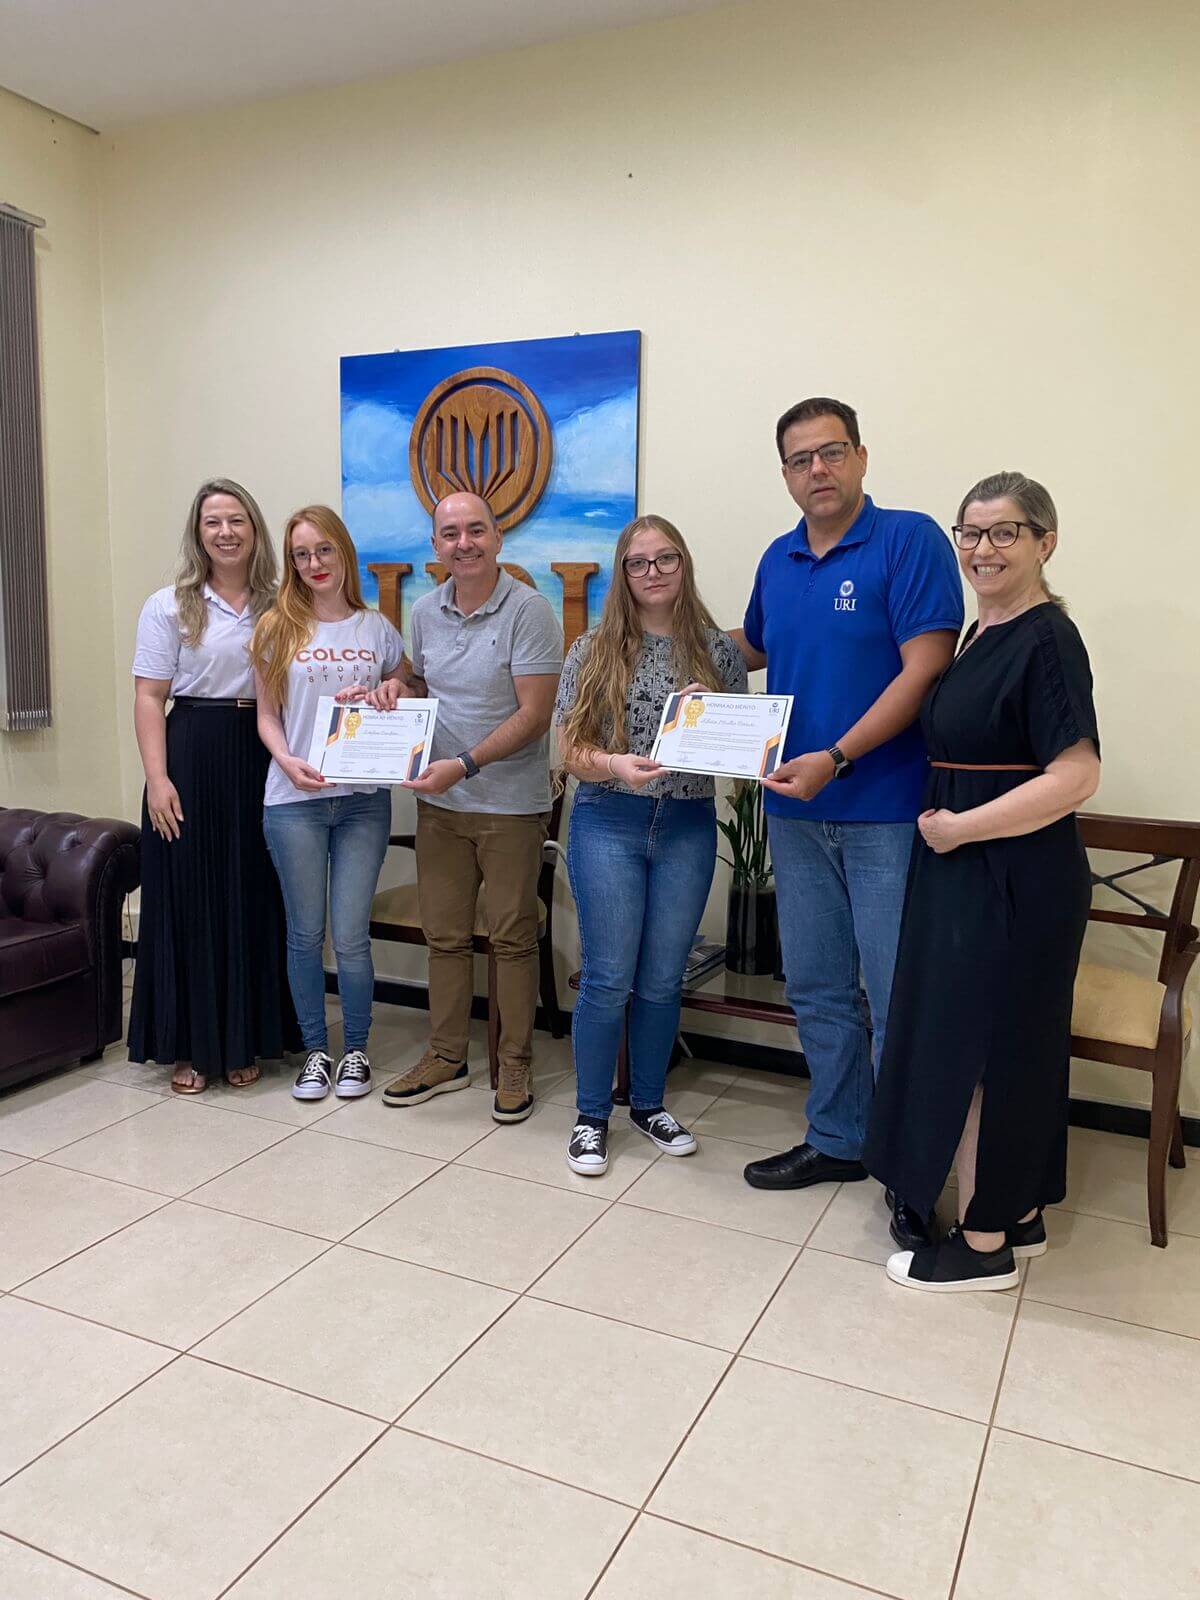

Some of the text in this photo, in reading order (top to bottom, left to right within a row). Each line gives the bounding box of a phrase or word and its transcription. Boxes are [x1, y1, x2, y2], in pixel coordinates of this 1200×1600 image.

[834, 598, 857, 611] URI
[295, 648, 377, 664] COLCCI
[306, 664, 372, 673] SPORT
[308, 674, 372, 683] STYLE
